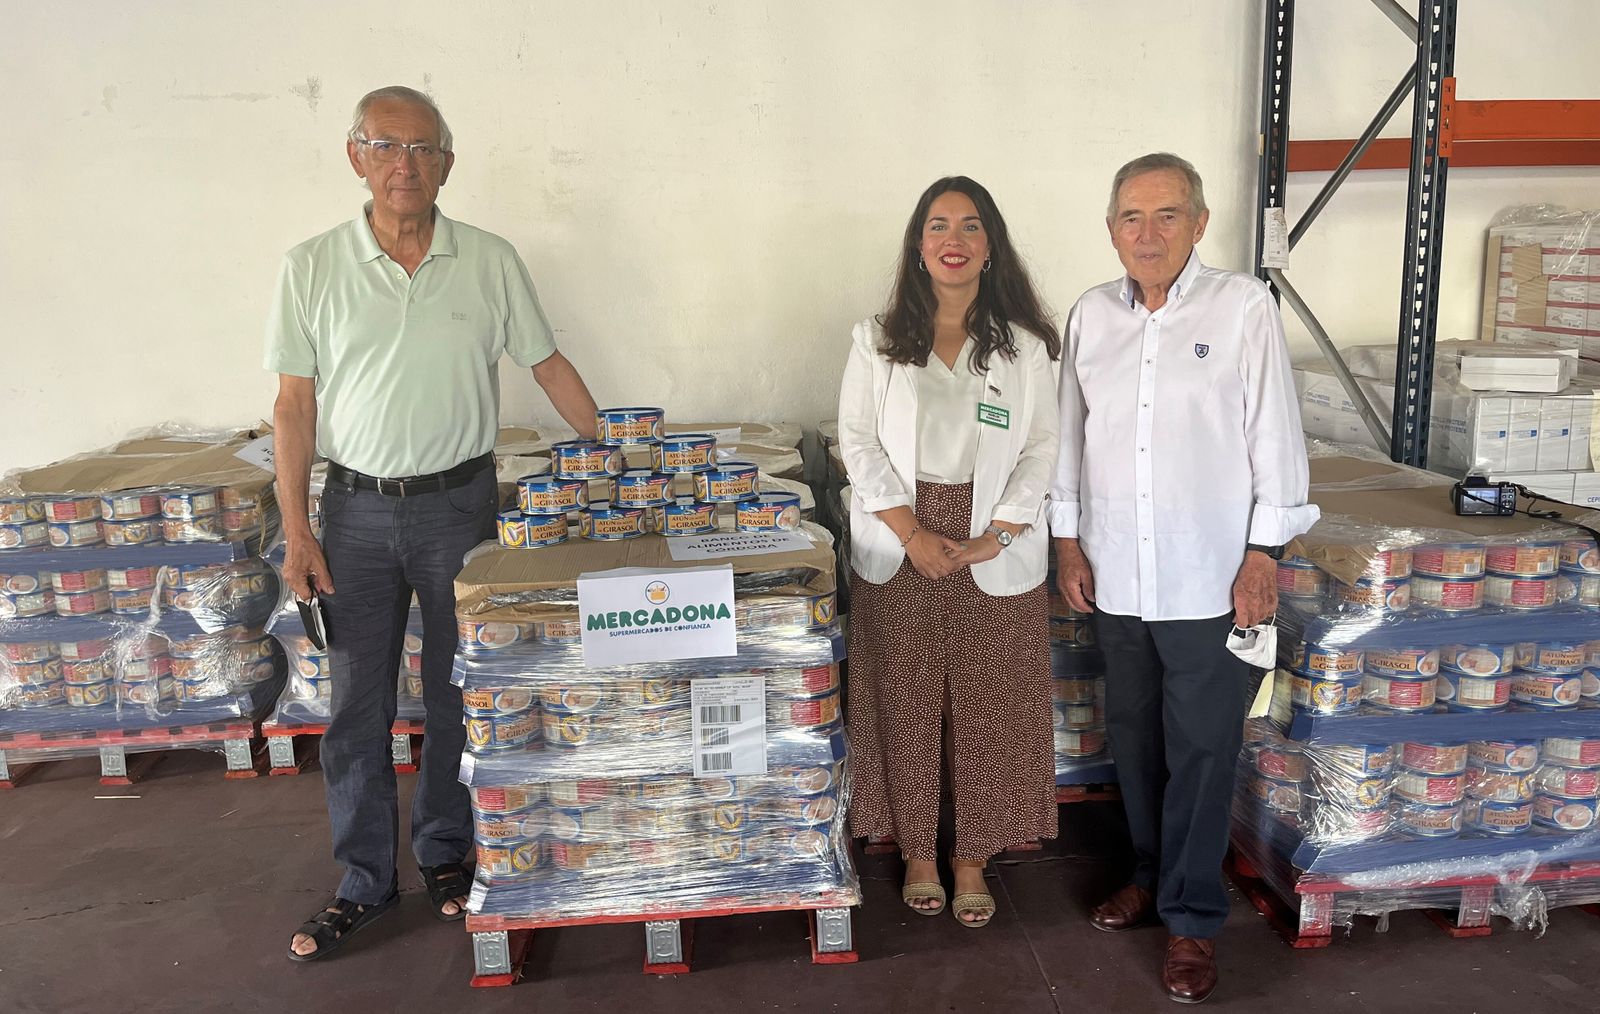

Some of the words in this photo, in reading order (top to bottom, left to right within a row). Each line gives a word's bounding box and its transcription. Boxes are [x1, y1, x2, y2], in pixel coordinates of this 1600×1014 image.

[673, 458, 704, 466] GIRASOL
[567, 464, 600, 472] GIRASOL
[719, 486, 749, 495] GIRASOL
[626, 492, 658, 500] GIRASOL
[539, 499, 573, 507] GIRASOL
[675, 520, 707, 528] GIRASOL
[742, 518, 771, 526] GIRASOL
[603, 525, 634, 533] GIRASOL
[701, 535, 750, 543] BANCO
[687, 540, 768, 549] ALIMENTOS
[587, 603, 731, 631] MERCADONA
[609, 627, 663, 638] SUPERMERCADOS
[674, 623, 711, 632] CONFIANZA
[1373, 659, 1411, 670] GIRASOL
